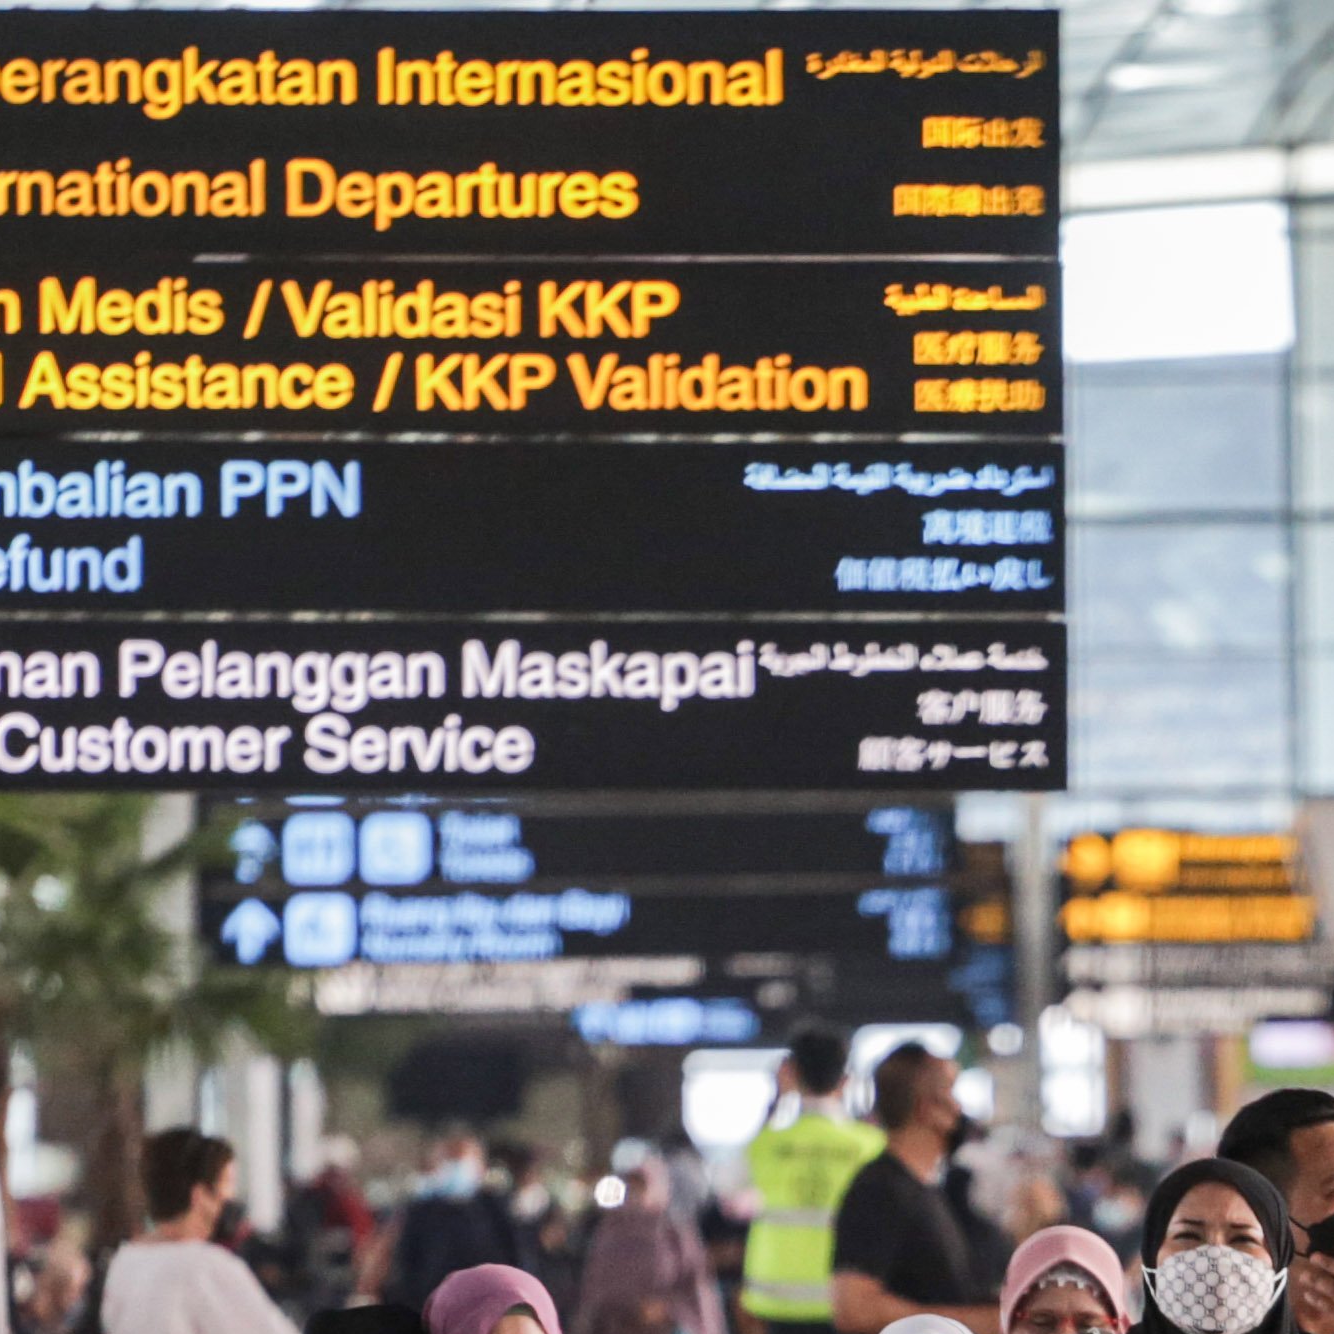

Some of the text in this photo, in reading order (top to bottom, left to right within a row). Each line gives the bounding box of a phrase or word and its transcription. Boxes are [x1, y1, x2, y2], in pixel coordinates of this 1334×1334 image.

[376, 47, 784, 107] Internasional
[285, 157, 640, 232] Departures
[38, 276, 225, 336] Medis
[280, 279, 522, 339] Validasi
[538, 280, 681, 339] KKP
[17, 350, 355, 410] Assistance
[414, 352, 557, 411] KKP
[565, 352, 869, 411] Validation
[220, 459, 362, 518] PPN
[116, 639, 446, 714] Pelanggan
[461, 639, 756, 713] Maskapai
[303, 713, 536, 774] Service
